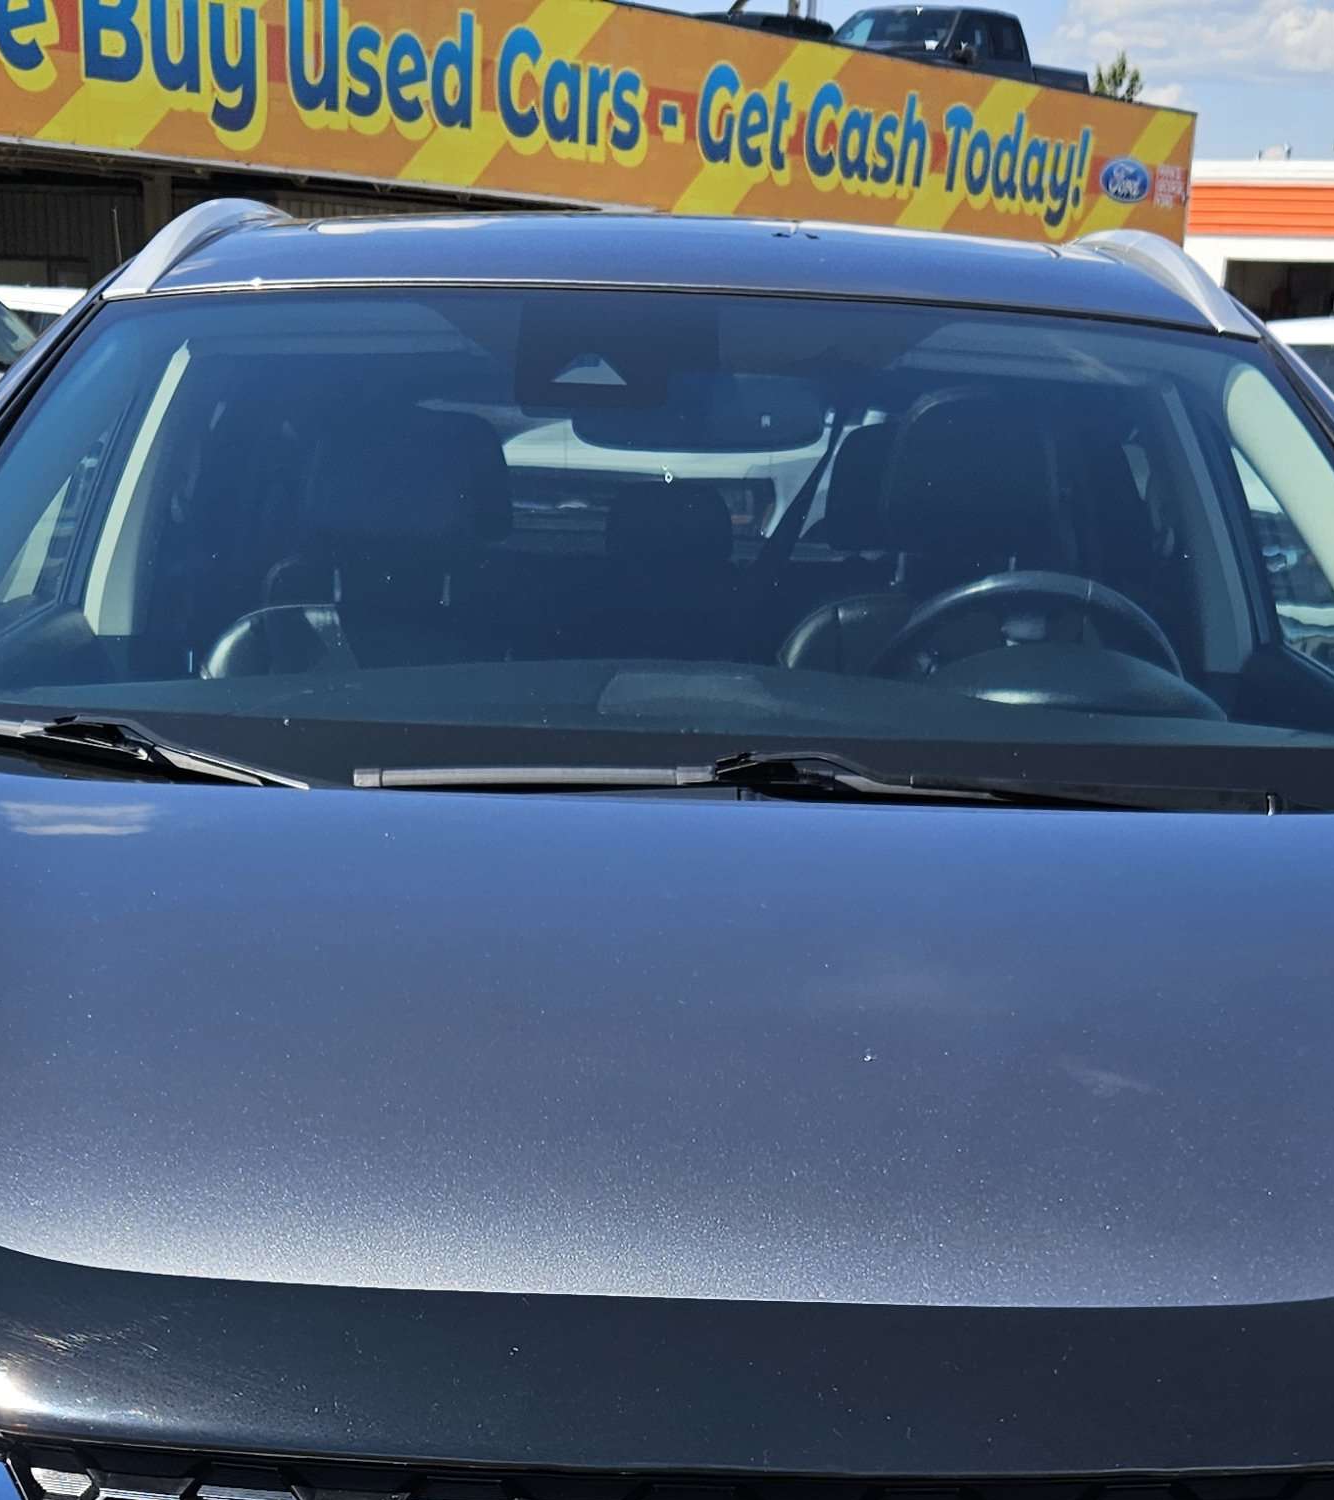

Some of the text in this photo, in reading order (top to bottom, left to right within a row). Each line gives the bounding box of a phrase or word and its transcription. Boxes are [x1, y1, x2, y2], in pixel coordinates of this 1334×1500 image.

[81, 0, 259, 133] Buy
[286, 0, 475, 130] Used
[497, 25, 643, 153] Cars
[697, 62, 793, 172] Get
[804, 81, 929, 188] Cash
[944, 104, 1093, 228] Today!
